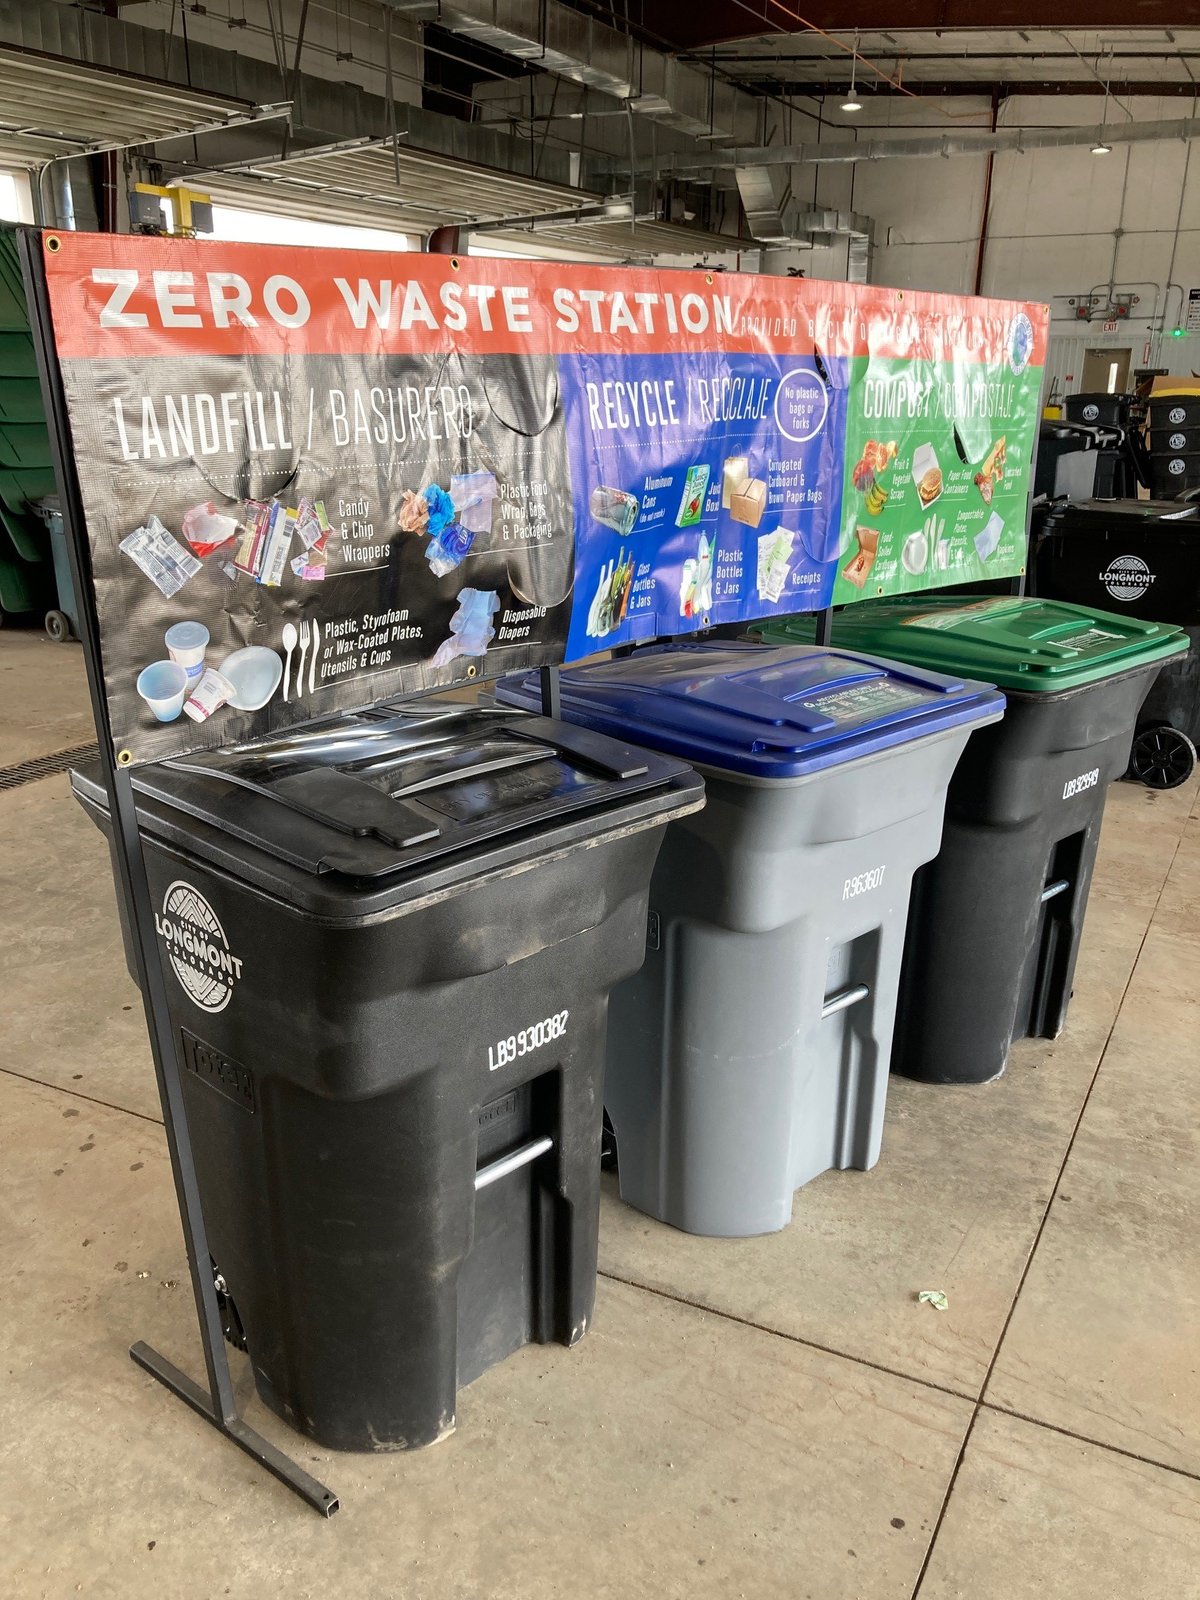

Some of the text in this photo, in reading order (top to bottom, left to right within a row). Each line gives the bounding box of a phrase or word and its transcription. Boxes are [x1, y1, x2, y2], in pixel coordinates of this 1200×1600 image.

[92, 268, 733, 336] ZERO WASTE STATION
[741, 316, 797, 337] PROVIDED
[1104, 323, 1117, 331] EXIT
[785, 386, 819, 401] No plastic
[863, 379, 932, 418] COMPOST
[944, 381, 1016, 418] COMPOSTAJE
[586, 380, 680, 430] RECYCLE
[789, 402, 814, 416] bags or
[114, 390, 292, 461] LANDFILL
[329, 384, 473, 446] BASURERO
[792, 416, 810, 429] forks
[768, 458, 802, 473] Corrugated
[644, 475, 673, 491] Aluminum
[768, 474, 805, 488] Cardboard &
[960, 469, 972, 480] Food
[500, 480, 548, 499] Plastic Food
[768, 489, 823, 505] Brown Paper Bags
[944, 484, 968, 494] Containers
[339, 500, 369, 518] Candy
[529, 501, 546, 519] Bags
[642, 495, 656, 509] Cans
[341, 521, 374, 540] & Chip
[502, 520, 553, 540] & Packaging
[342, 544, 391, 564] Wrappers
[717, 549, 743, 562] Plastic
[716, 565, 743, 578] Bottles
[792, 571, 821, 585] Receipts
[1098, 572, 1157, 584] LONGMONT
[633, 577, 656, 593] Bottles
[715, 582, 739, 594] & Jars
[636, 595, 651, 609] Jars
[503, 605, 547, 625] Disposable
[325, 609, 409, 639] Plastic, Styrofoam
[498, 625, 530, 641] Diapers
[323, 625, 424, 659] or Wax-Coated Plates,
[321, 648, 391, 678] Utensils & Cups
[842, 864, 886, 902] R963607
[180, 920, 209, 941] CITY OF
[154, 912, 243, 980] LONGMONT
[165, 940, 235, 987] COLORADO
